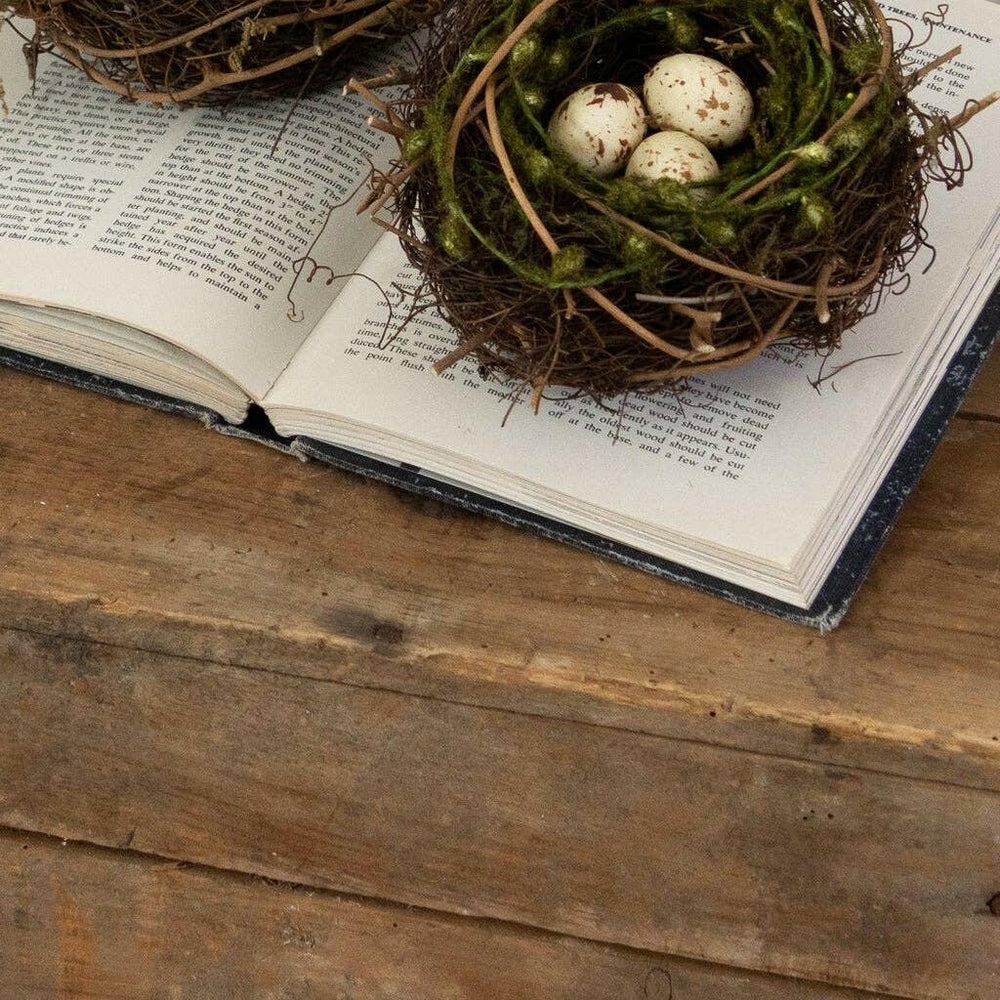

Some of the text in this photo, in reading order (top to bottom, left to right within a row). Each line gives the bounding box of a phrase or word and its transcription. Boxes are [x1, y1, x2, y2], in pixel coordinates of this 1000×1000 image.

[933, 75, 965, 90] to the
[945, 67, 971, 80] done
[954, 60, 975, 71] new
[926, 82, 943, 92] the
[148, 179, 191, 190] narrower
[205, 189, 221, 198] the
[222, 193, 239, 204] top
[241, 199, 263, 212] than
[277, 213, 294, 225] the
[295, 222, 314, 237] bot-
[154, 169, 165, 177] in
[167, 171, 197, 182] height
[200, 178, 233, 190] should
[235, 186, 248, 195] be
[250, 191, 275, 205] from
[295, 210, 306, 219] to
[134, 195, 166, 205] should
[166, 199, 179, 208] be
[180, 204, 215, 216] started
[215, 212, 231, 222] the
[232, 218, 253, 230] first
[254, 227, 286, 246] season
[164, 190, 203, 205] Shaping
[204, 199, 220, 208] the
[221, 203, 251, 218] hedge
[252, 214, 263, 223] in
[264, 220, 283, 232] this
[284, 229, 308, 247] form
[190, 217, 211, 226] and
[214, 223, 248, 239] should
[251, 236, 264, 247] be
[113, 219, 283, 283] hedge has acquired the desired
[120, 211, 289, 273] tained year after year until the
[141, 234, 161, 244] This
[163, 239, 187, 252] form
[189, 249, 226, 266] enables
[227, 262, 244, 274] the
[244, 271, 262, 284] sun
[264, 282, 275, 291] to
[92, 244, 125, 257] bottom
[131, 254, 151, 263] and
[156, 259, 182, 272] helps
[188, 270, 200, 278] to
[205, 278, 248, 302] maintain
[98, 237, 268, 301] strike the sides from the top to the
[414, 327, 422, 337] is
[344, 348, 360, 357] the
[366, 352, 394, 364] point
[400, 359, 426, 373] flush
[464, 379, 481, 390] the
[390, 345, 475, 376] These be
[705, 392, 775, 420] have become
[710, 383, 781, 410] will not need
[554, 398, 575, 413] ally
[578, 408, 596, 419] the
[636, 430, 666, 444] wood
[669, 441, 707, 458] should
[710, 453, 724, 463] be
[727, 461, 745, 470] cut
[580, 398, 593, 406] as
[651, 423, 665, 431] as
[665, 426, 675, 436] it
[676, 432, 720, 451] appears.
[725, 446, 750, 459] Usu-
[649, 410, 679, 424] wood
[681, 421, 719, 437] should
[722, 433, 735, 443] be
[739, 440, 757, 450] cut
[692, 413, 763, 442] and fruiting
[742, 417, 770, 430] dead
[548, 410, 566, 420] off
[568, 418, 580, 426] at
[584, 423, 602, 434] the
[639, 444, 661, 455] and
[678, 455, 699, 467] few
[704, 465, 718, 473] of
[722, 470, 740, 480] the
